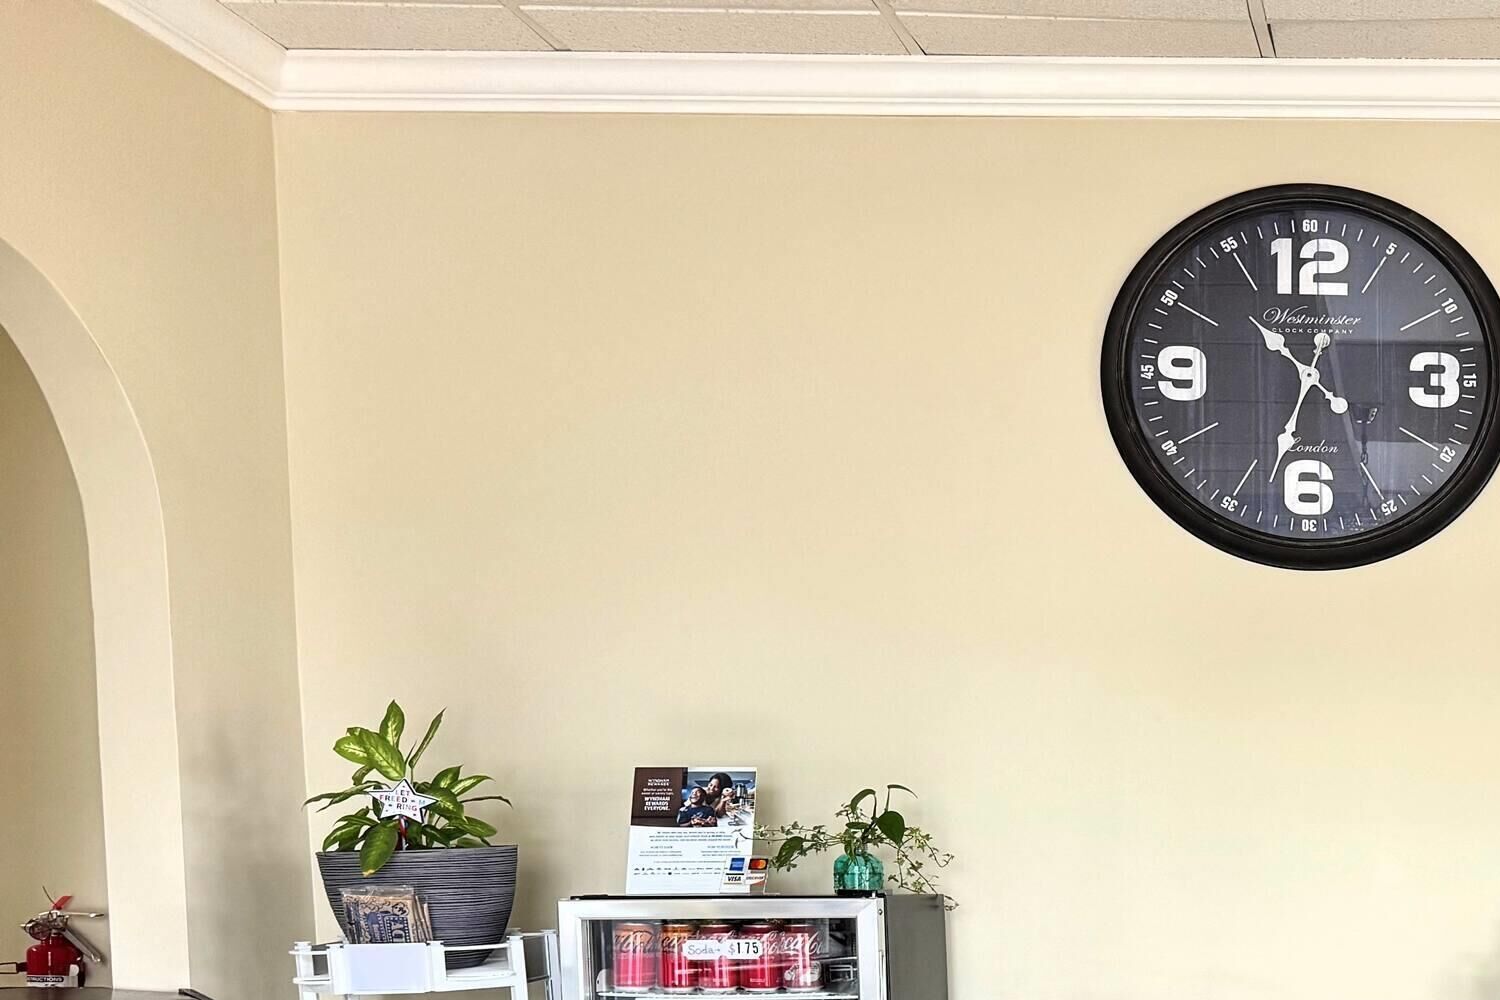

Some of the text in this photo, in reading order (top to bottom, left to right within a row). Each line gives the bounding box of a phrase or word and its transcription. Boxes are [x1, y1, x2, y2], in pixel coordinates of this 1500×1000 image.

[1302, 219, 1318, 233] 60
[1220, 237, 1239, 253] 55
[1386, 242, 1397, 256] 5
[1270, 237, 1349, 296] 12
[1160, 289, 1178, 307] 50
[1442, 297, 1458, 314] 10
[1263, 305, 1361, 326] Westminster
[1140, 364, 1154, 380] 45
[1157, 346, 1207, 401] 9
[1408, 351, 1460, 408] 3
[1463, 373, 1477, 388] 15
[1161, 440, 1179, 455] 40
[1288, 436, 1339, 453] London
[1439, 446, 1456, 464] 20
[1284, 459, 1334, 516] 6
[1220, 496, 1238, 512] 35
[1381, 499, 1398, 516] 25
[1301, 518, 1317, 532] 30
